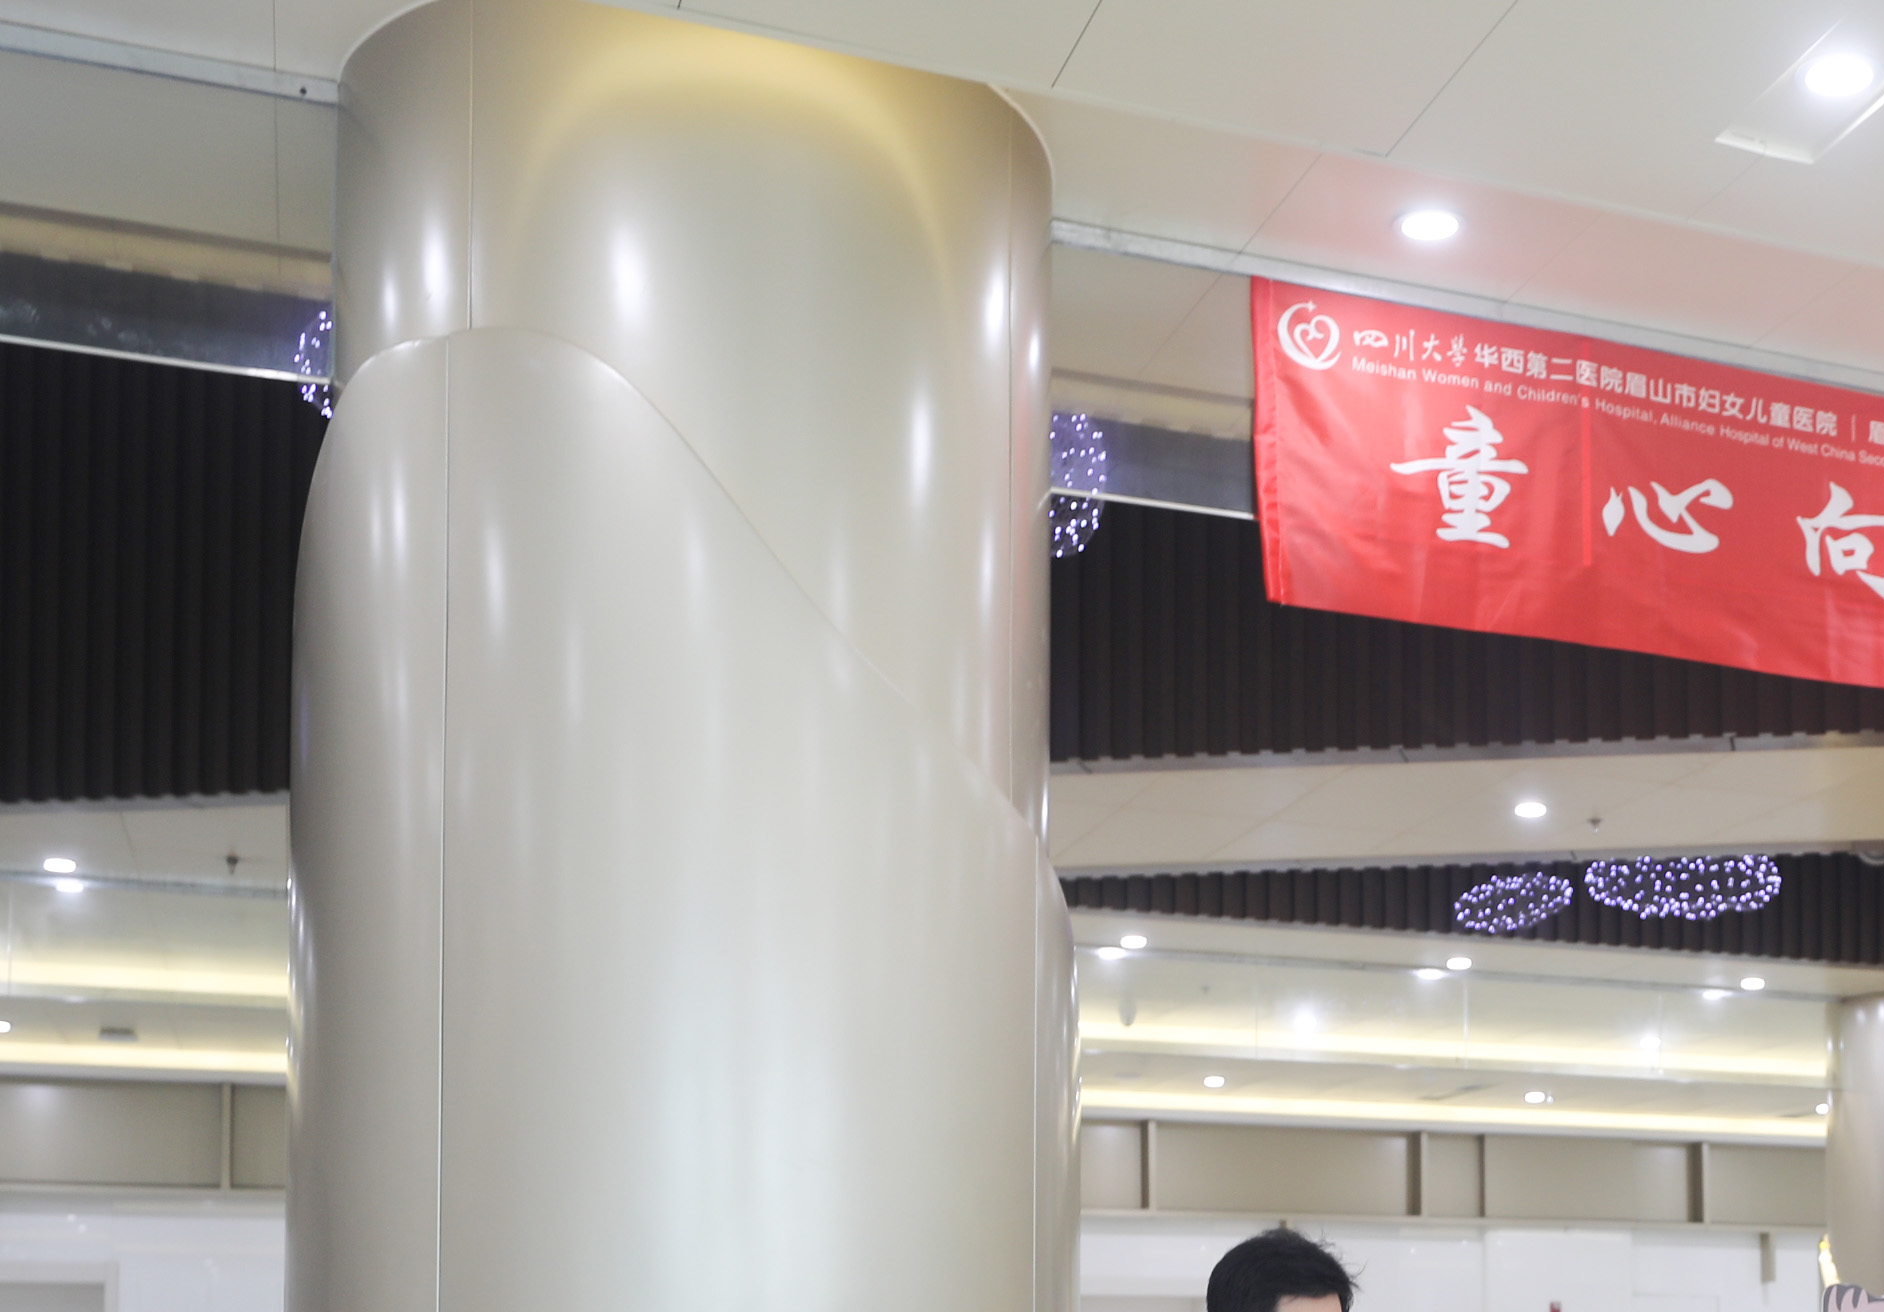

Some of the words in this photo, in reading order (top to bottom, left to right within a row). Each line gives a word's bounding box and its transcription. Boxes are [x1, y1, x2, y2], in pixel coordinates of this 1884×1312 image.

[1351, 356, 1417, 381] Meishan
[1421, 369, 1479, 389] Women
[1484, 378, 1513, 397] and
[1517, 384, 1590, 409] Children's
[1660, 412, 1715, 436] Alliance
[1719, 427, 1770, 447] Hospital
[1772, 434, 1785, 449] of
[1786, 438, 1819, 456] West
[1820, 443, 1856, 463] China
